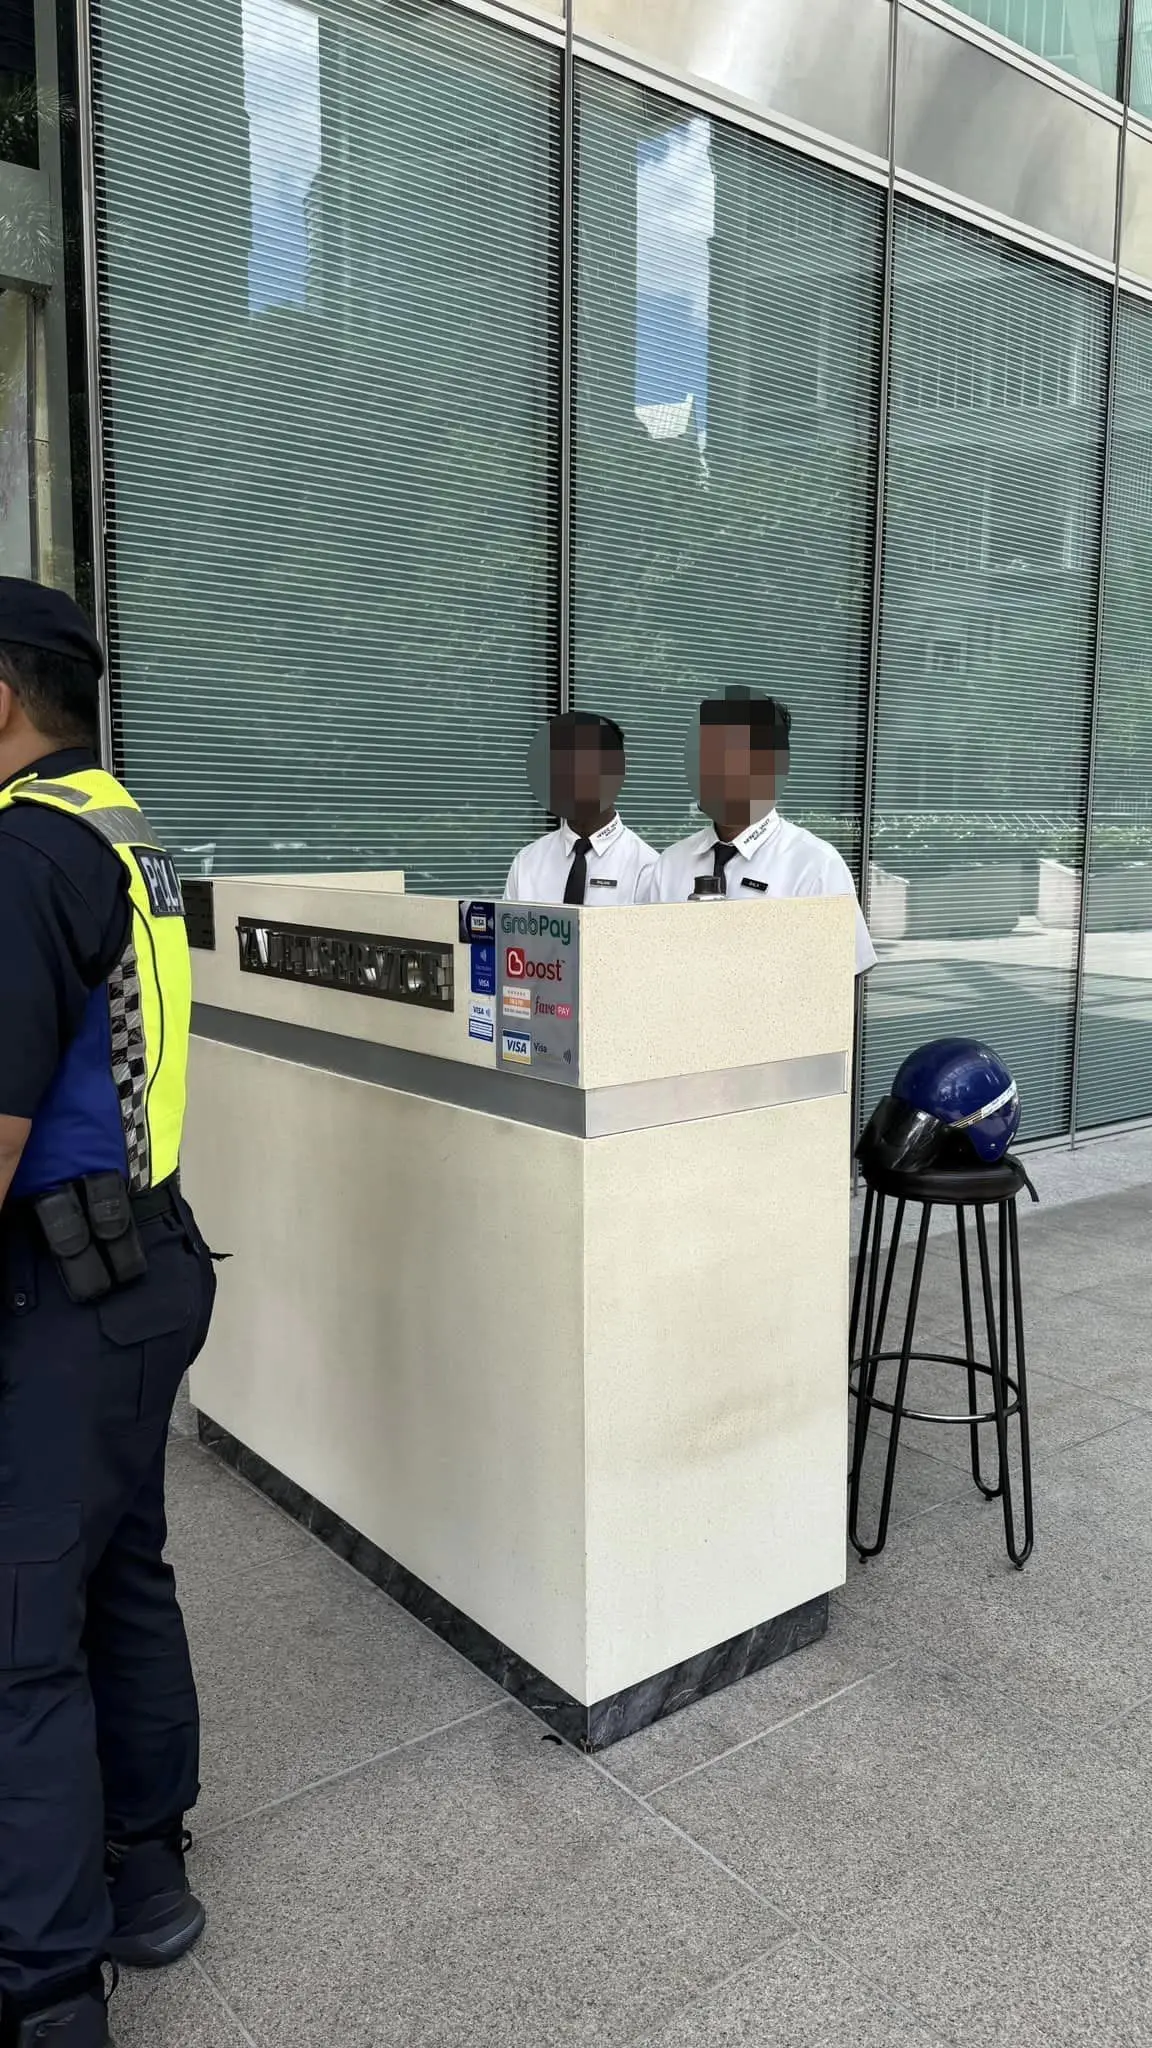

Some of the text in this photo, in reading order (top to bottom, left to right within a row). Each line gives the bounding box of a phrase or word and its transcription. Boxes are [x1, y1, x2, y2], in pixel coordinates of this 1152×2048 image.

[501, 911, 571, 946] GrabPay
[508, 950, 562, 981] Boost
[478, 978, 490, 988] VISA
[472, 1005, 485, 1015] VISA
[507, 1039, 527, 1054] VISA
